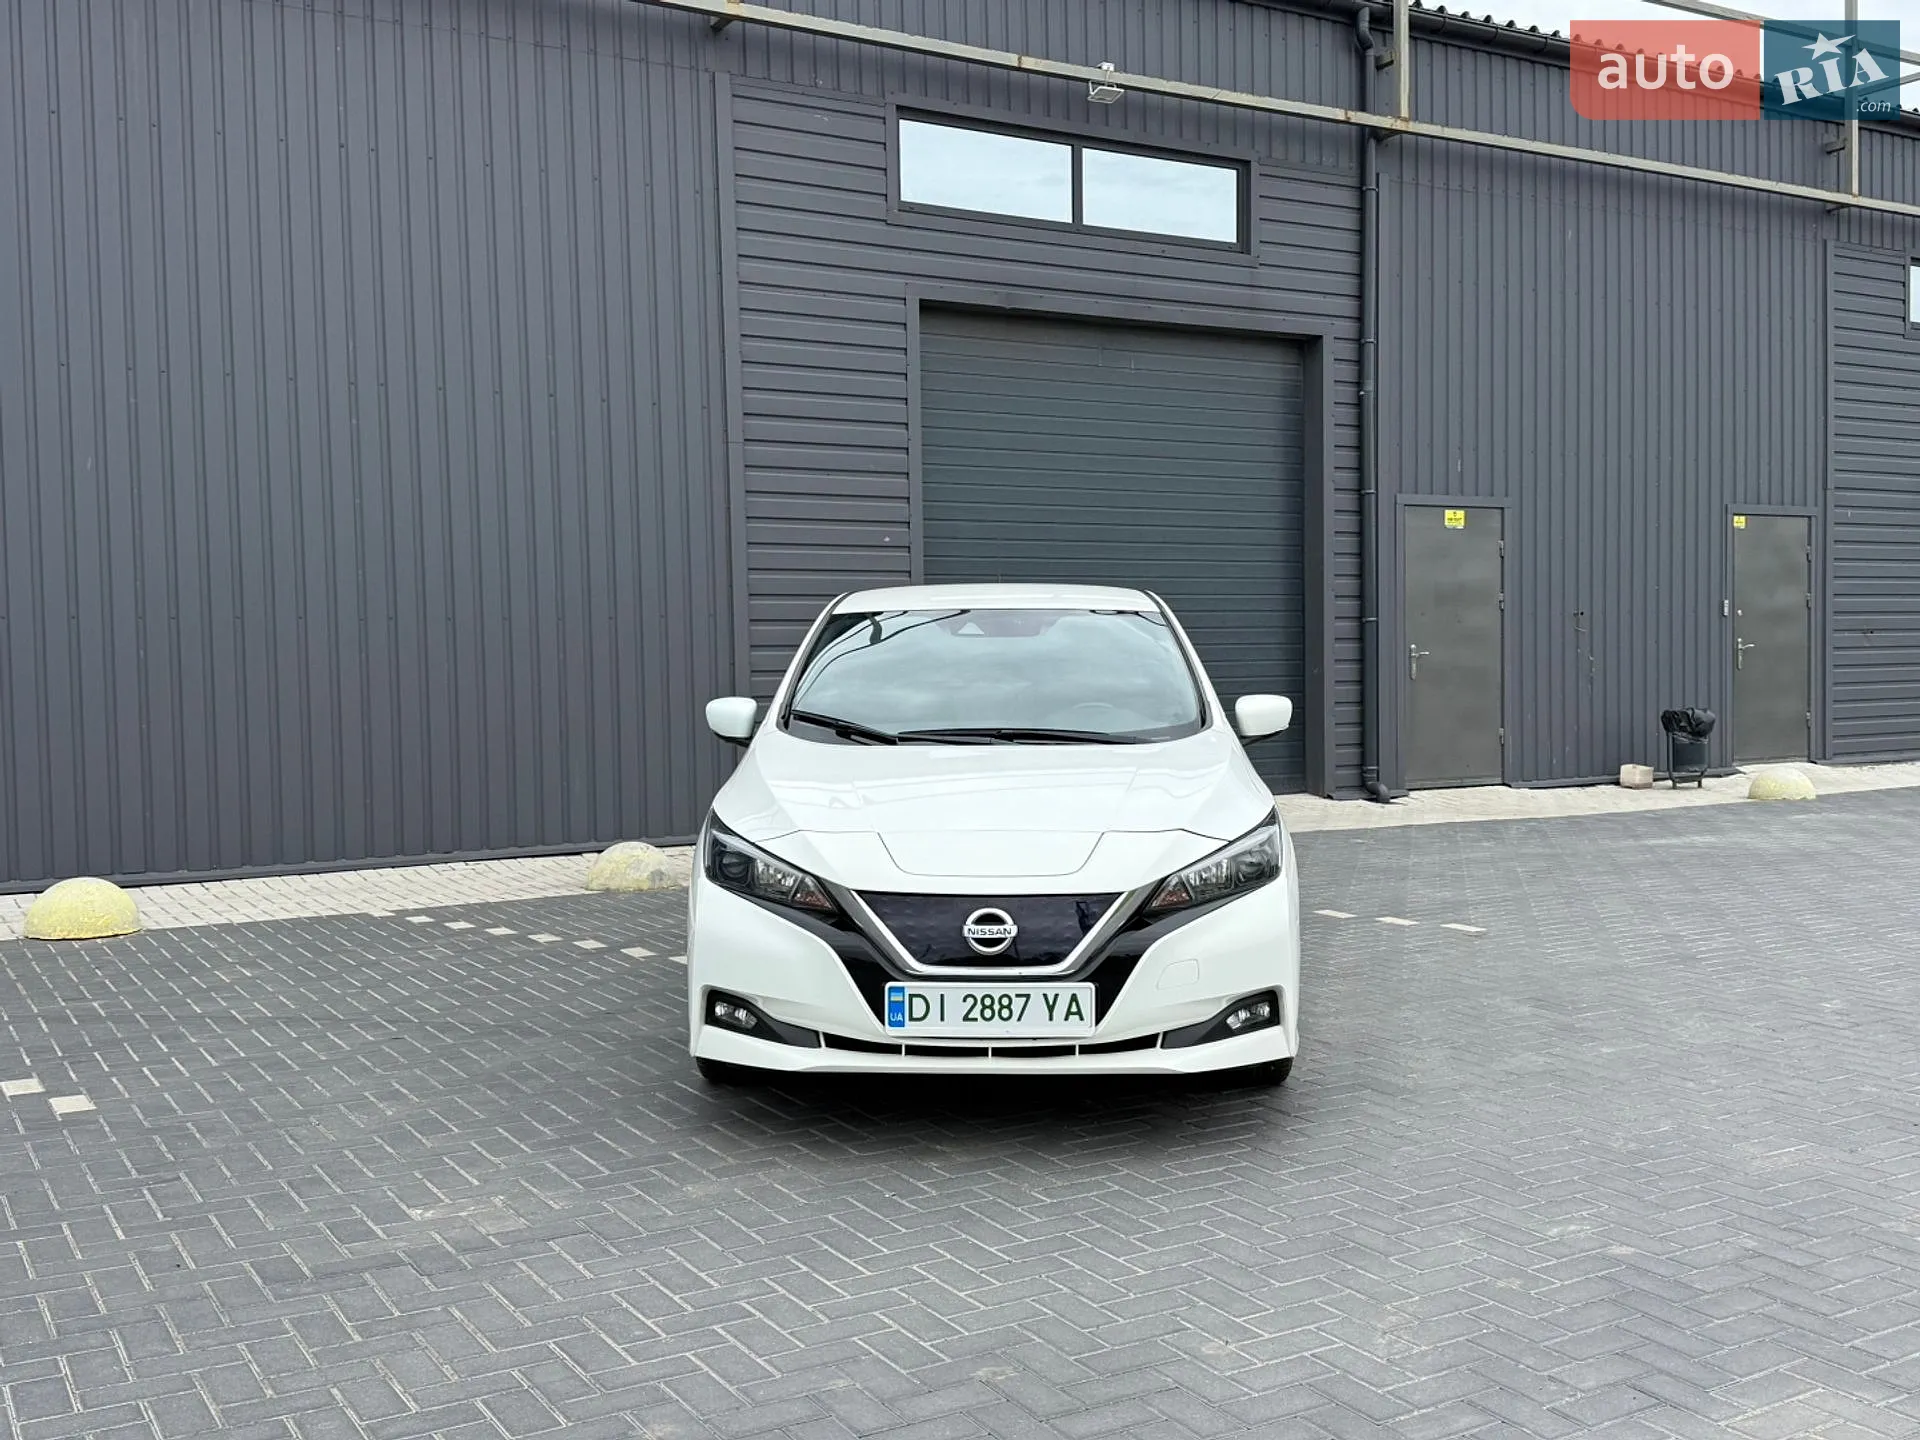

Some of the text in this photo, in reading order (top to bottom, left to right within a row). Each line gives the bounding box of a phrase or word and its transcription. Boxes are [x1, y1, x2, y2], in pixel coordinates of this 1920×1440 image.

[968, 927, 1012, 936] NISSAN
[908, 993, 1085, 1022] DI 2887 YA
[889, 1012, 904, 1022] UA
